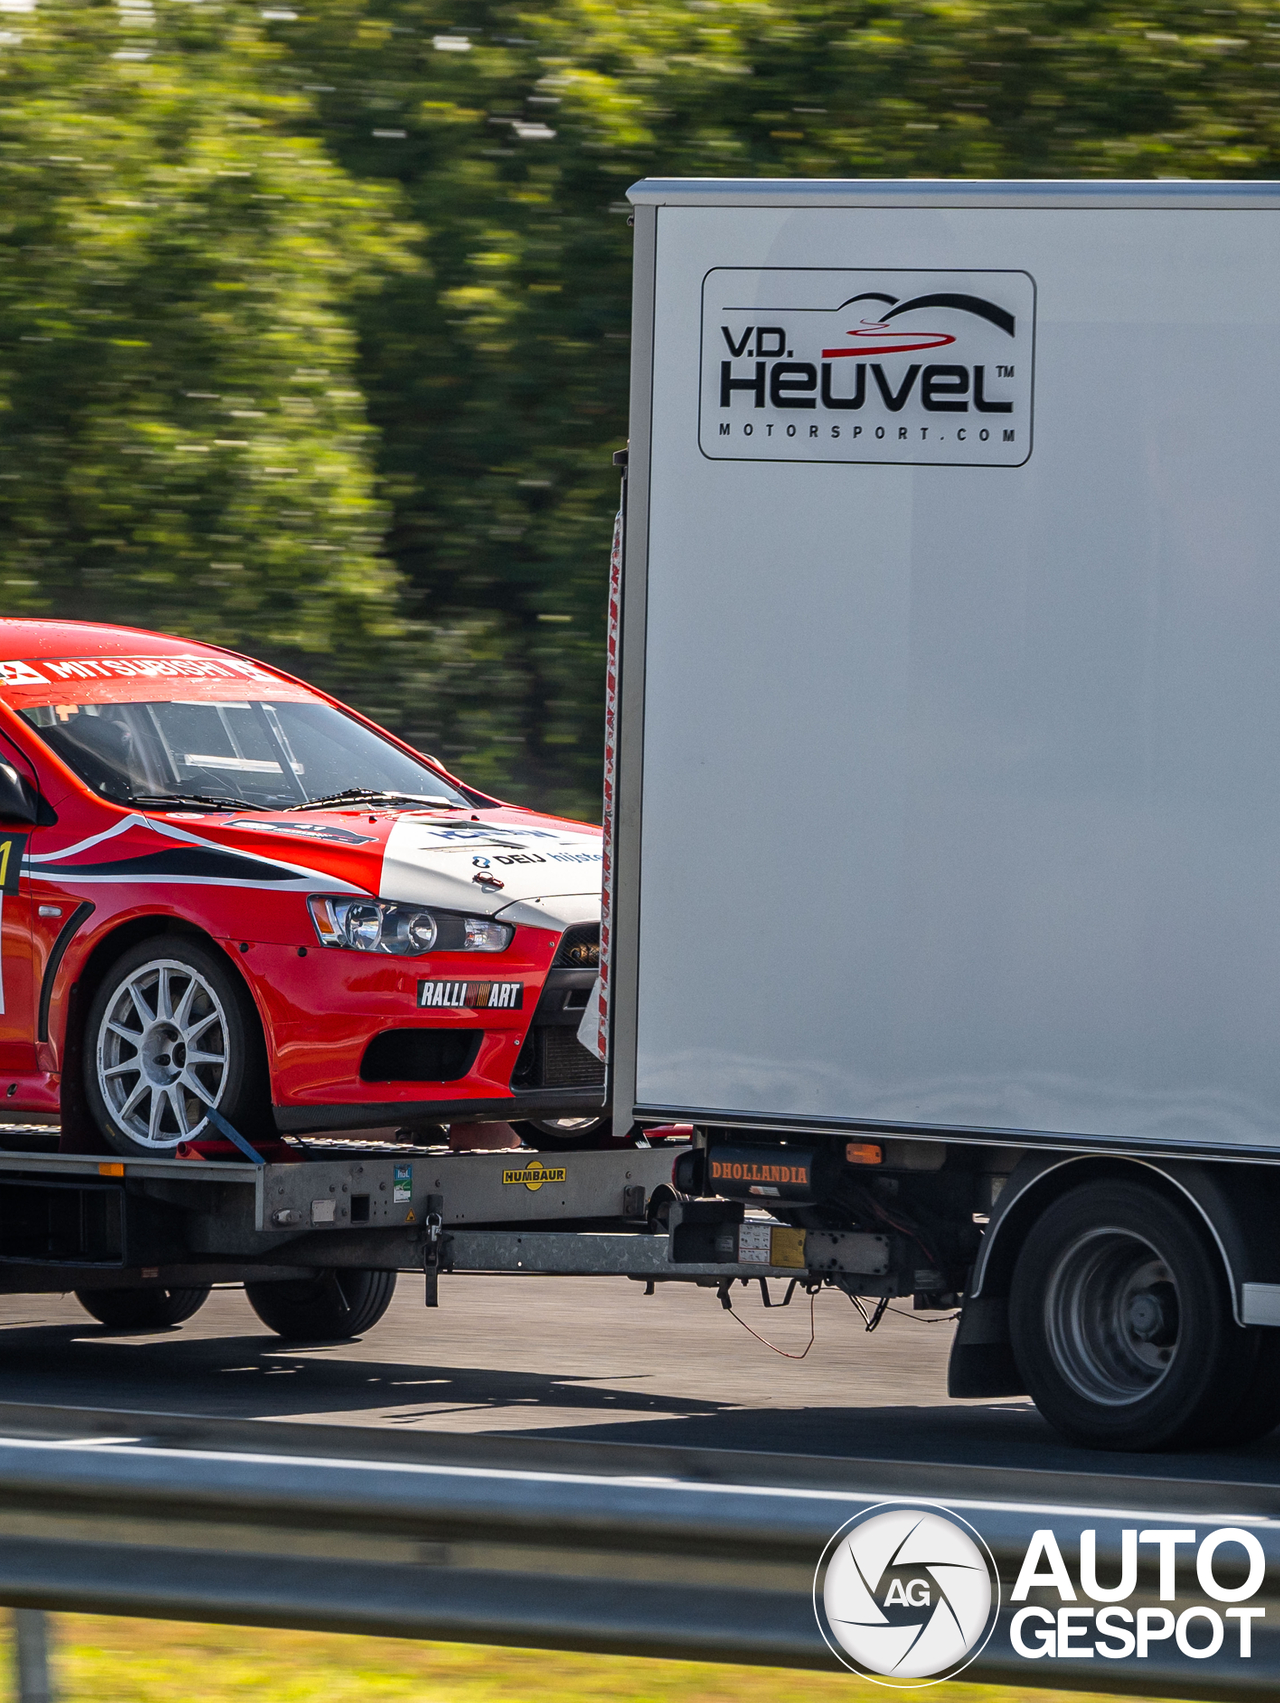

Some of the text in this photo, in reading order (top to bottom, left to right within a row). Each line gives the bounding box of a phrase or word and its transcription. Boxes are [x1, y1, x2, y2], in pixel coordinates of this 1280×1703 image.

[721, 326, 794, 358] V.D.
[719, 423, 1015, 442] MOTORSPORT.COM
[43, 660, 236, 679] MITSUBISHI
[493, 854, 547, 865] DEIJ
[505, 1169, 564, 1182] HUMBAUR
[712, 1162, 808, 1184] DHOLLANDIA
